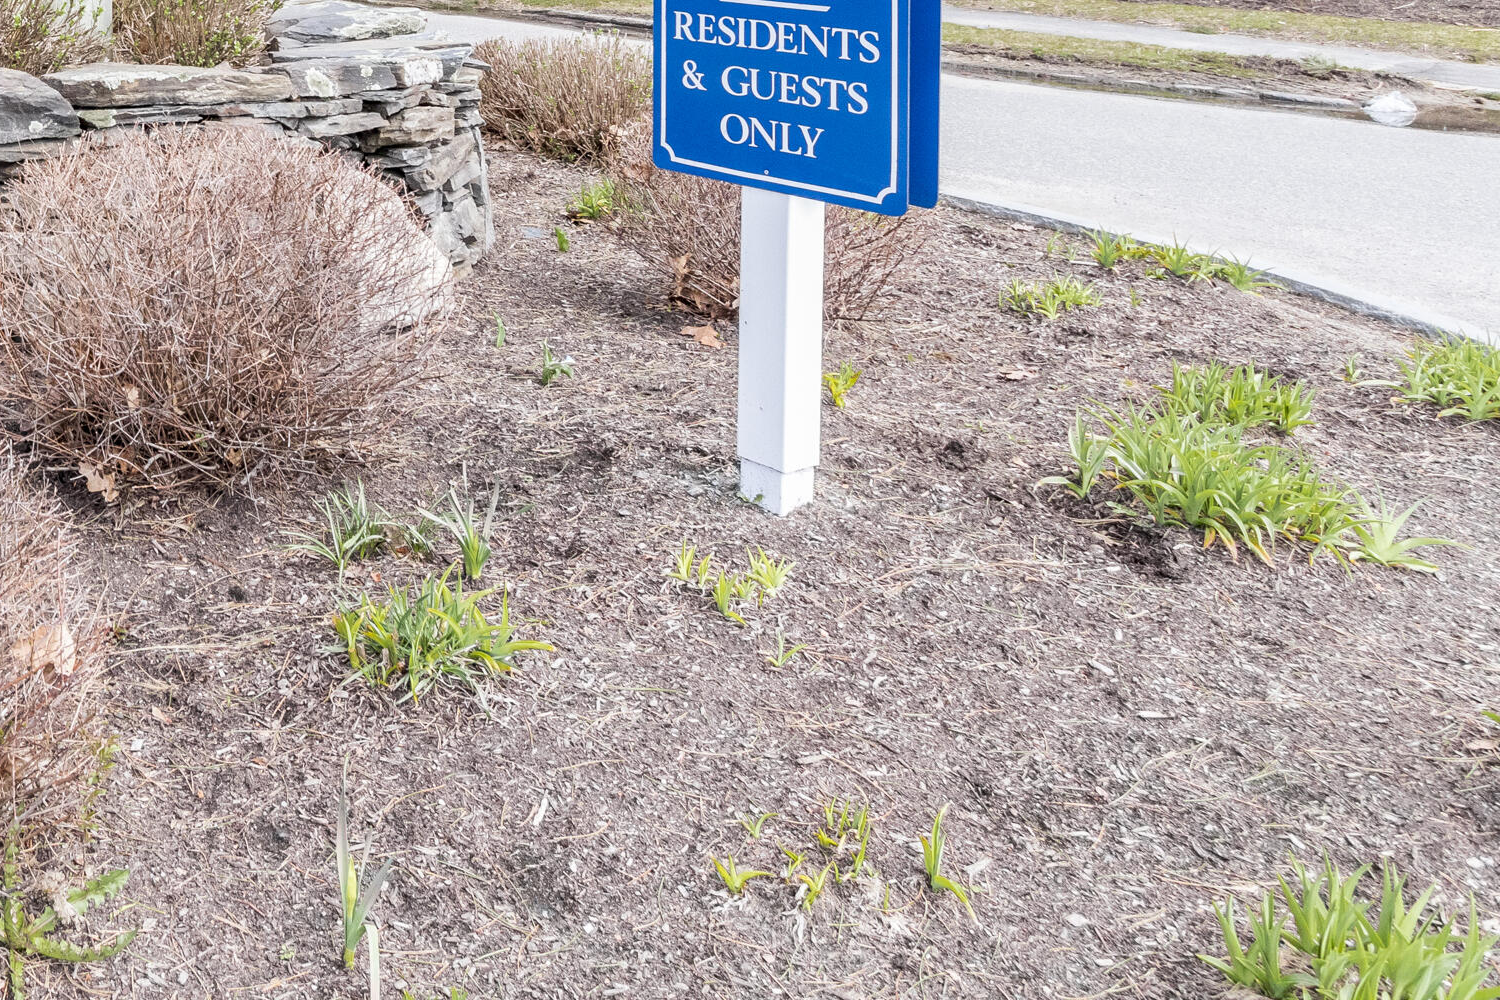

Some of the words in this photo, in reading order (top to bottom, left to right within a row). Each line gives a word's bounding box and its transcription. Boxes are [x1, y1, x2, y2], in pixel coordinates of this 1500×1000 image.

[673, 10, 880, 64] RESIDENTS
[681, 59, 708, 91] &
[721, 65, 869, 115] GUESTS
[720, 113, 825, 159] ONLY
